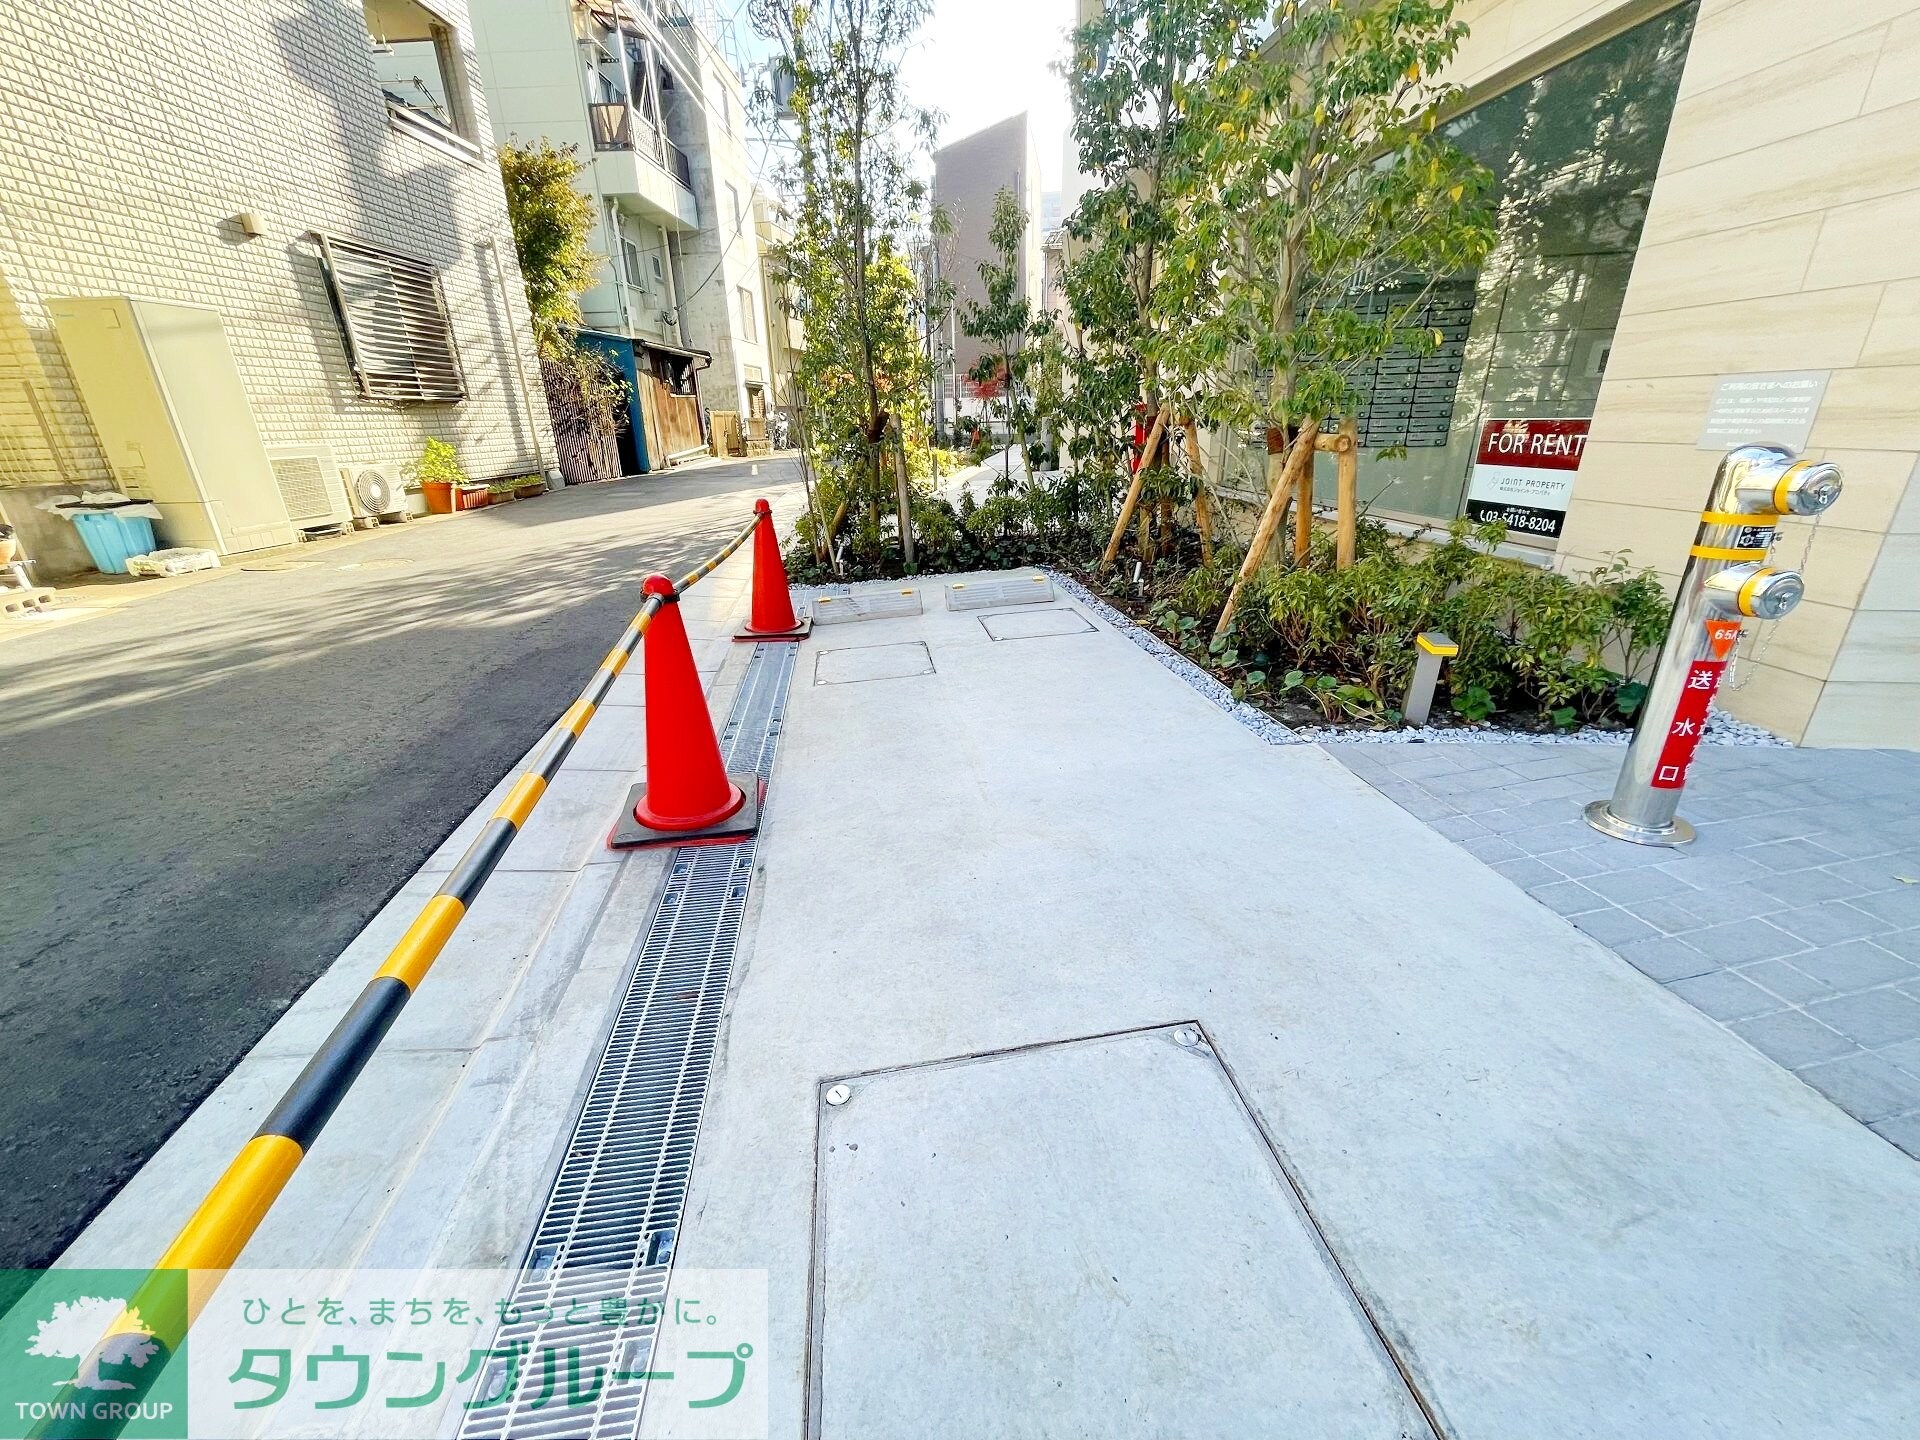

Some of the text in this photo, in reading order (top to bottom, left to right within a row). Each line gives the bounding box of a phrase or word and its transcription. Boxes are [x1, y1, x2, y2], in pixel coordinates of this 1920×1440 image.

[1487, 432, 1588, 457] FOR RENT
[1500, 477, 1566, 491] JOINT PROPERTY
